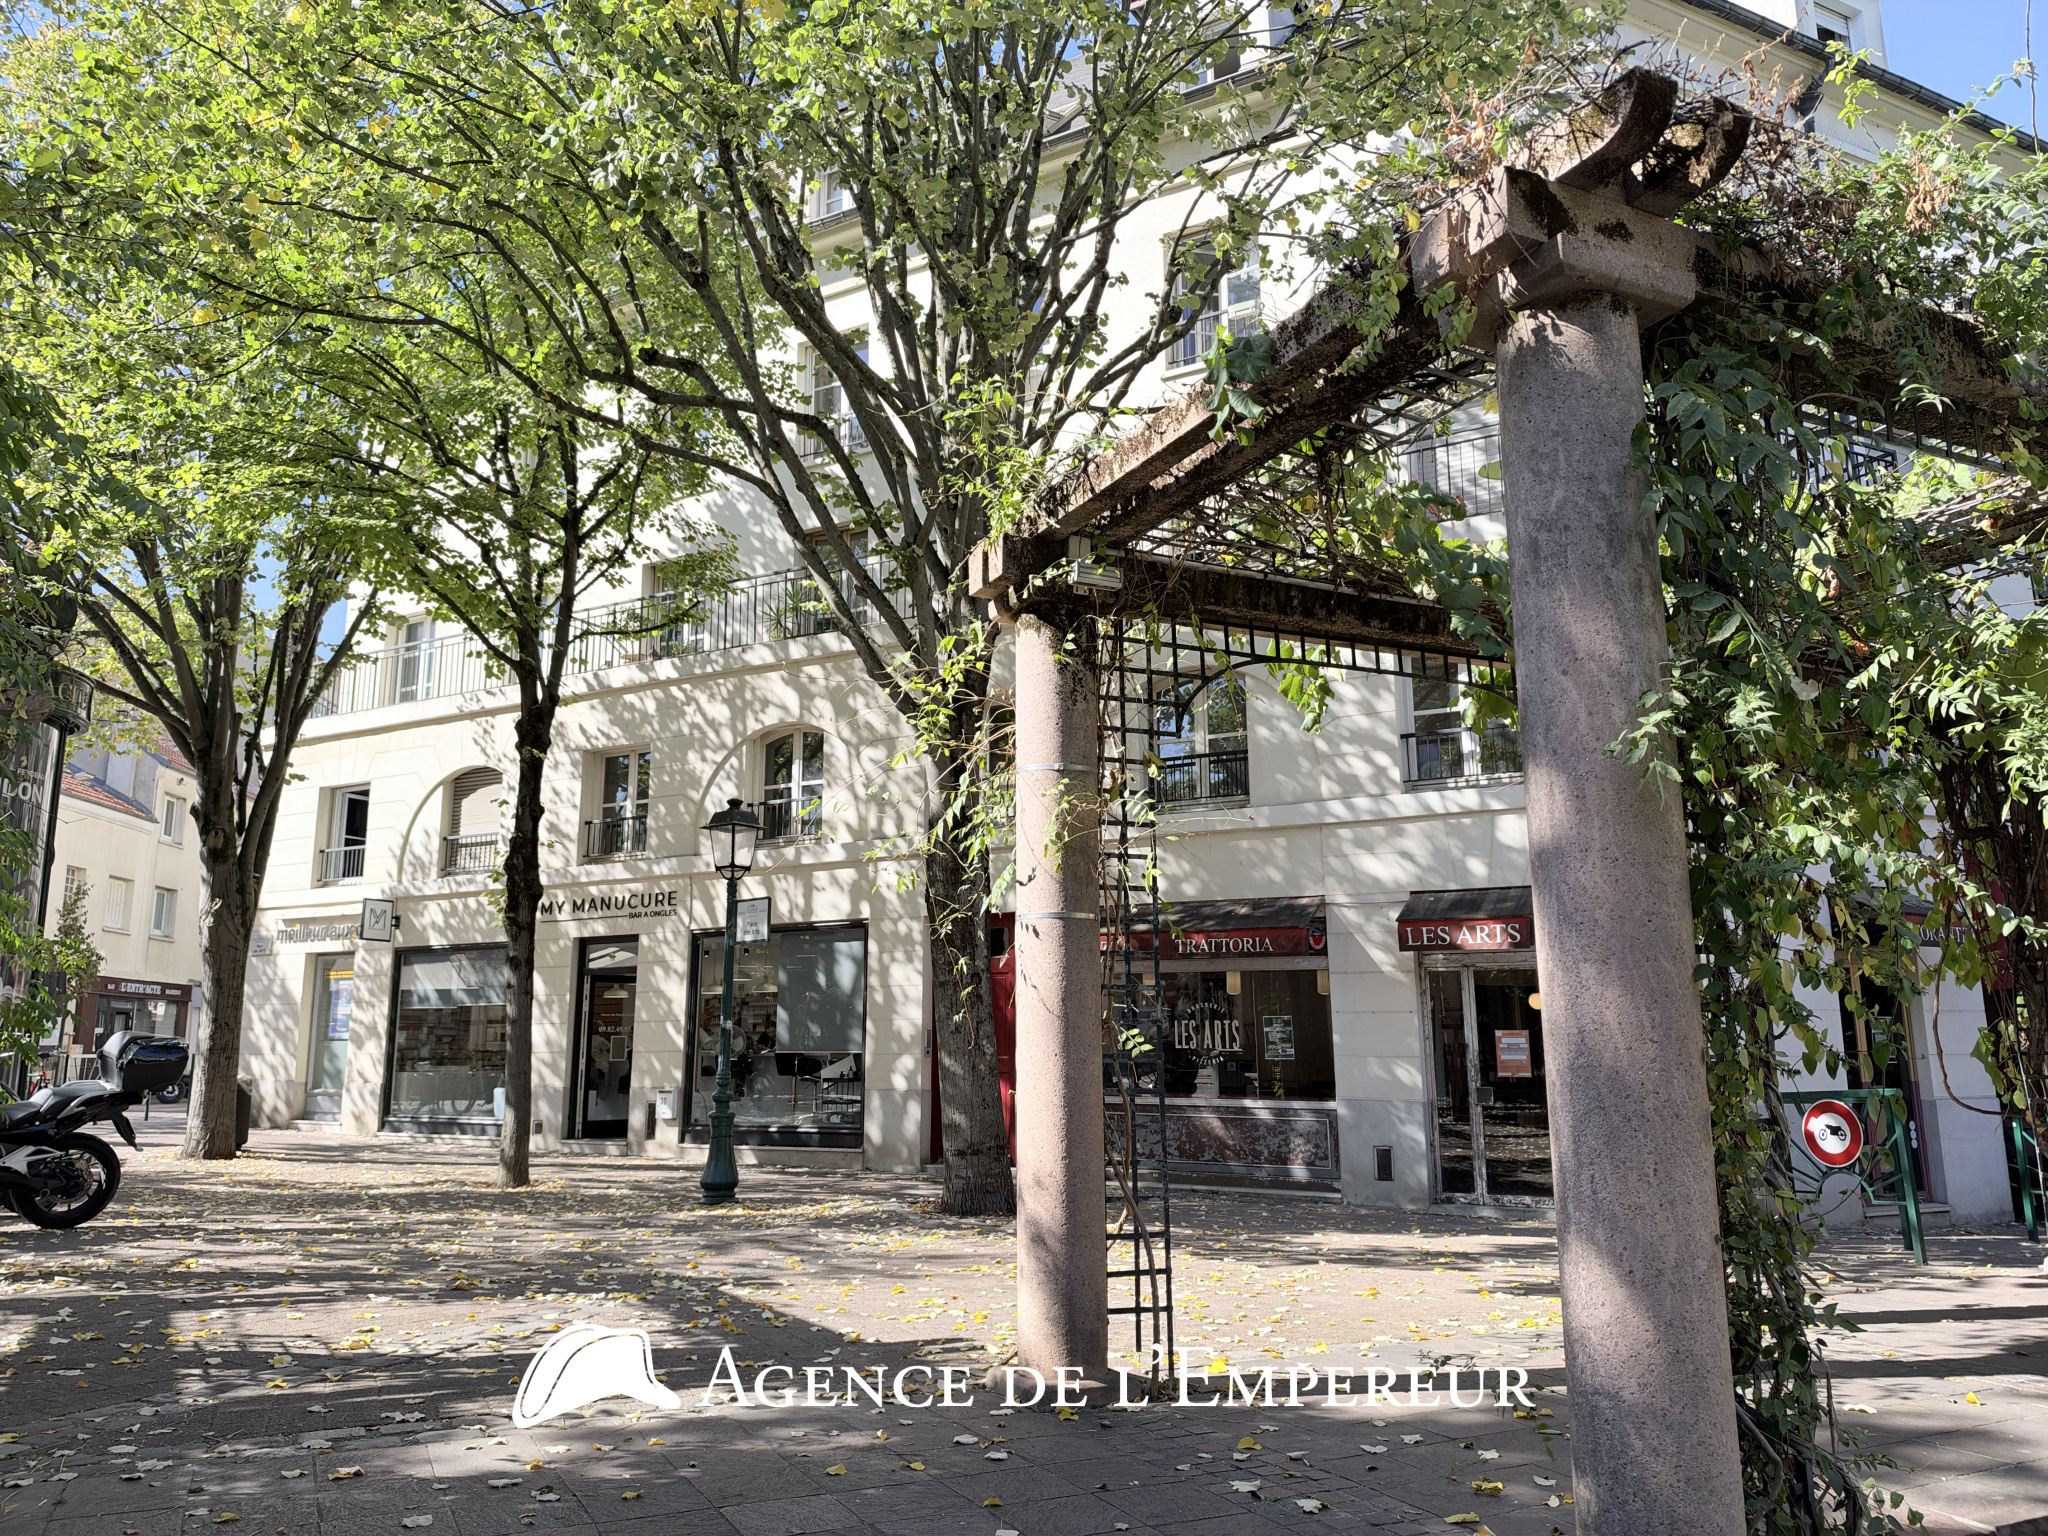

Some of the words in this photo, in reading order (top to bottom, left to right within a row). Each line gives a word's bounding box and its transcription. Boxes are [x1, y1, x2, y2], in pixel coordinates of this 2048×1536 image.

[540, 901, 565, 916] MY
[572, 891, 678, 914] MANUCURE
[628, 911, 642, 919] BAR
[649, 909, 677, 917] ONGLES
[1405, 925, 1451, 946] LES
[1455, 923, 1521, 945] ARTS
[1175, 937, 1274, 954] TRATTORIA
[1186, 1002, 1226, 1014] BRASSERIE
[1174, 1019, 1197, 1050] LES
[1203, 1019, 1240, 1050] ARTS
